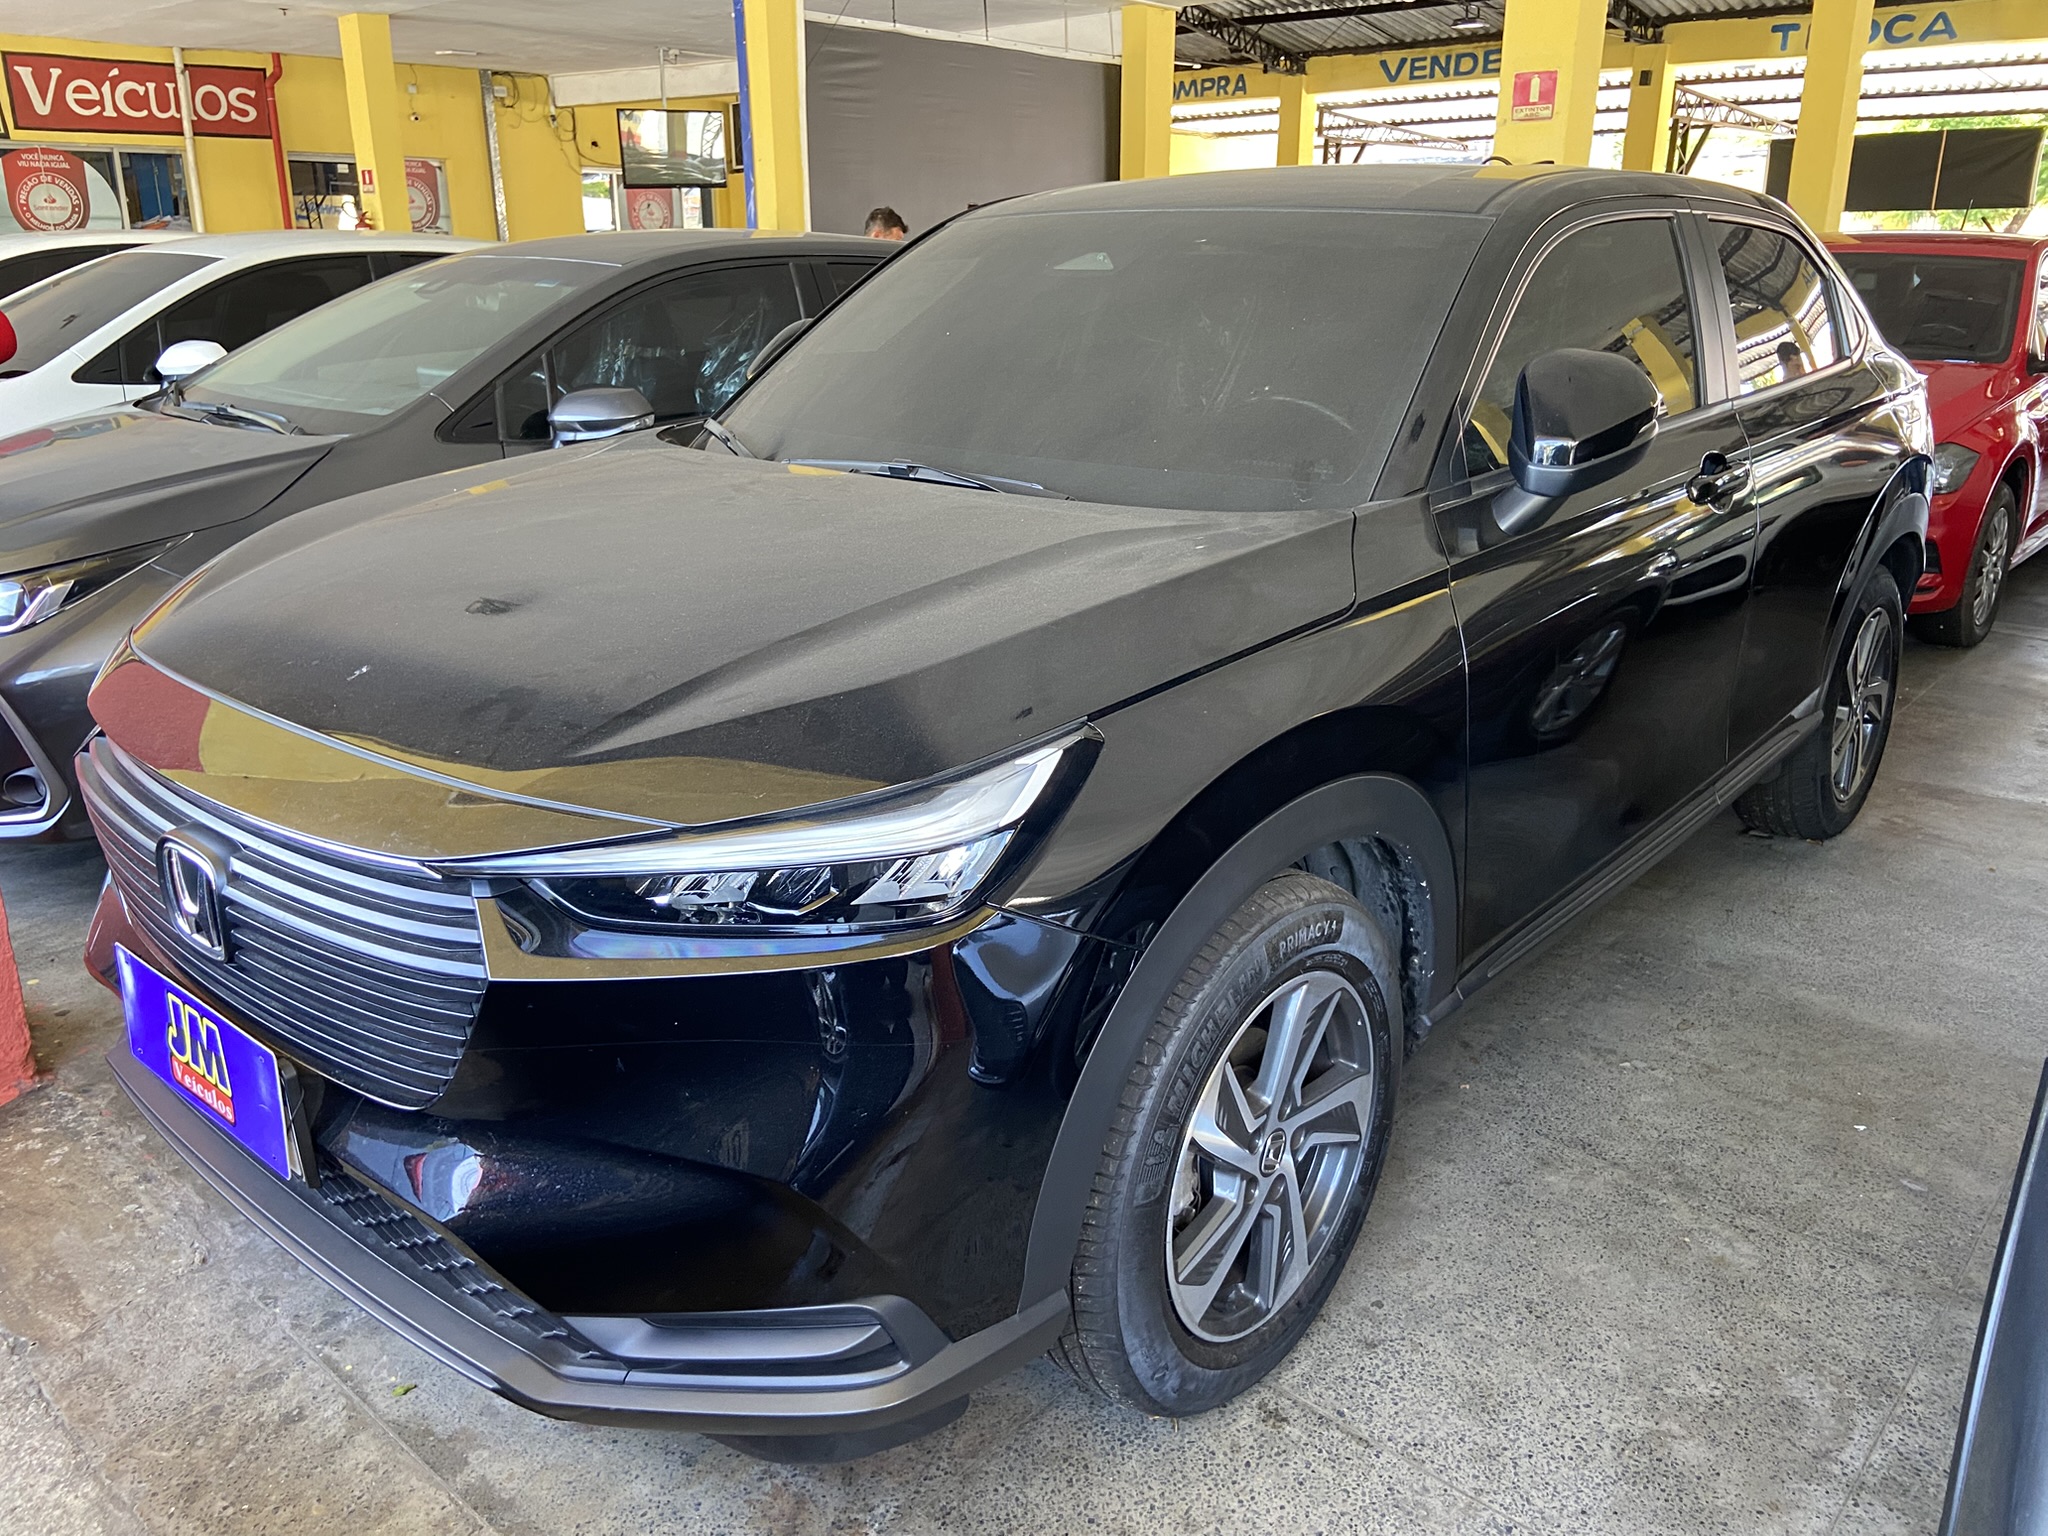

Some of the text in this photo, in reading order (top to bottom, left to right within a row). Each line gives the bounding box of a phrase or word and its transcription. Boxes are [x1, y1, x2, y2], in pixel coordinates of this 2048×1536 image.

[1770, 11, 1958, 52] TCA
[1379, 49, 1501, 84] VENDE
[13, 65, 258, 123] Veículos
[1173, 73, 1247, 101] MPRA
[1514, 106, 1551, 114] EXTINTOR
[19, 175, 80, 205] PREGÃO DE VENDAS
[29, 218, 54, 231] MELHOR
[1279, 920, 1331, 960] PRIMACY
[167, 991, 232, 1098] JM
[1166, 957, 1264, 1121] MICHELIN
